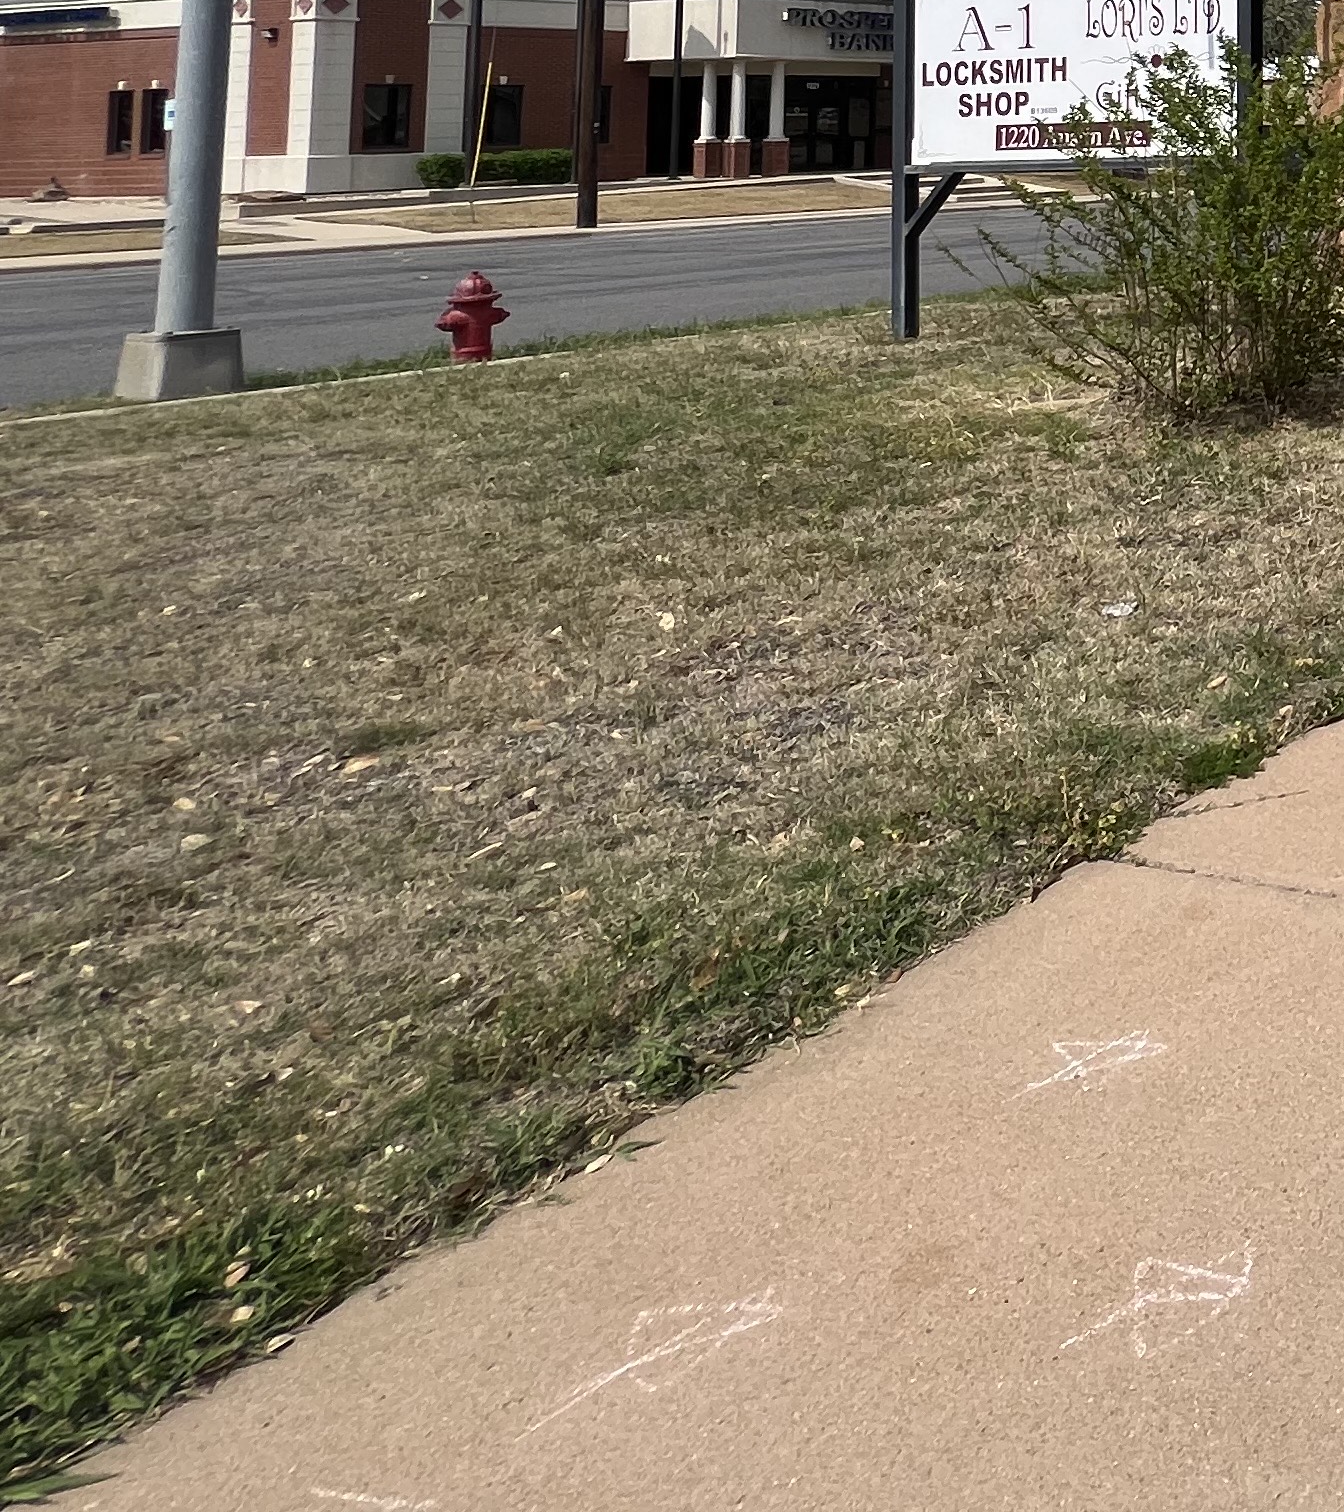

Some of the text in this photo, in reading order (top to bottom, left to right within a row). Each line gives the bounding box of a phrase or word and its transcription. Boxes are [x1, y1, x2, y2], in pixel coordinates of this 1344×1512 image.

[952, 3, 1036, 52] A-1
[922, 57, 1067, 87] LOCKSMITH
[959, 91, 1030, 117] SHOP
[999, 125, 1040, 149] 1220
